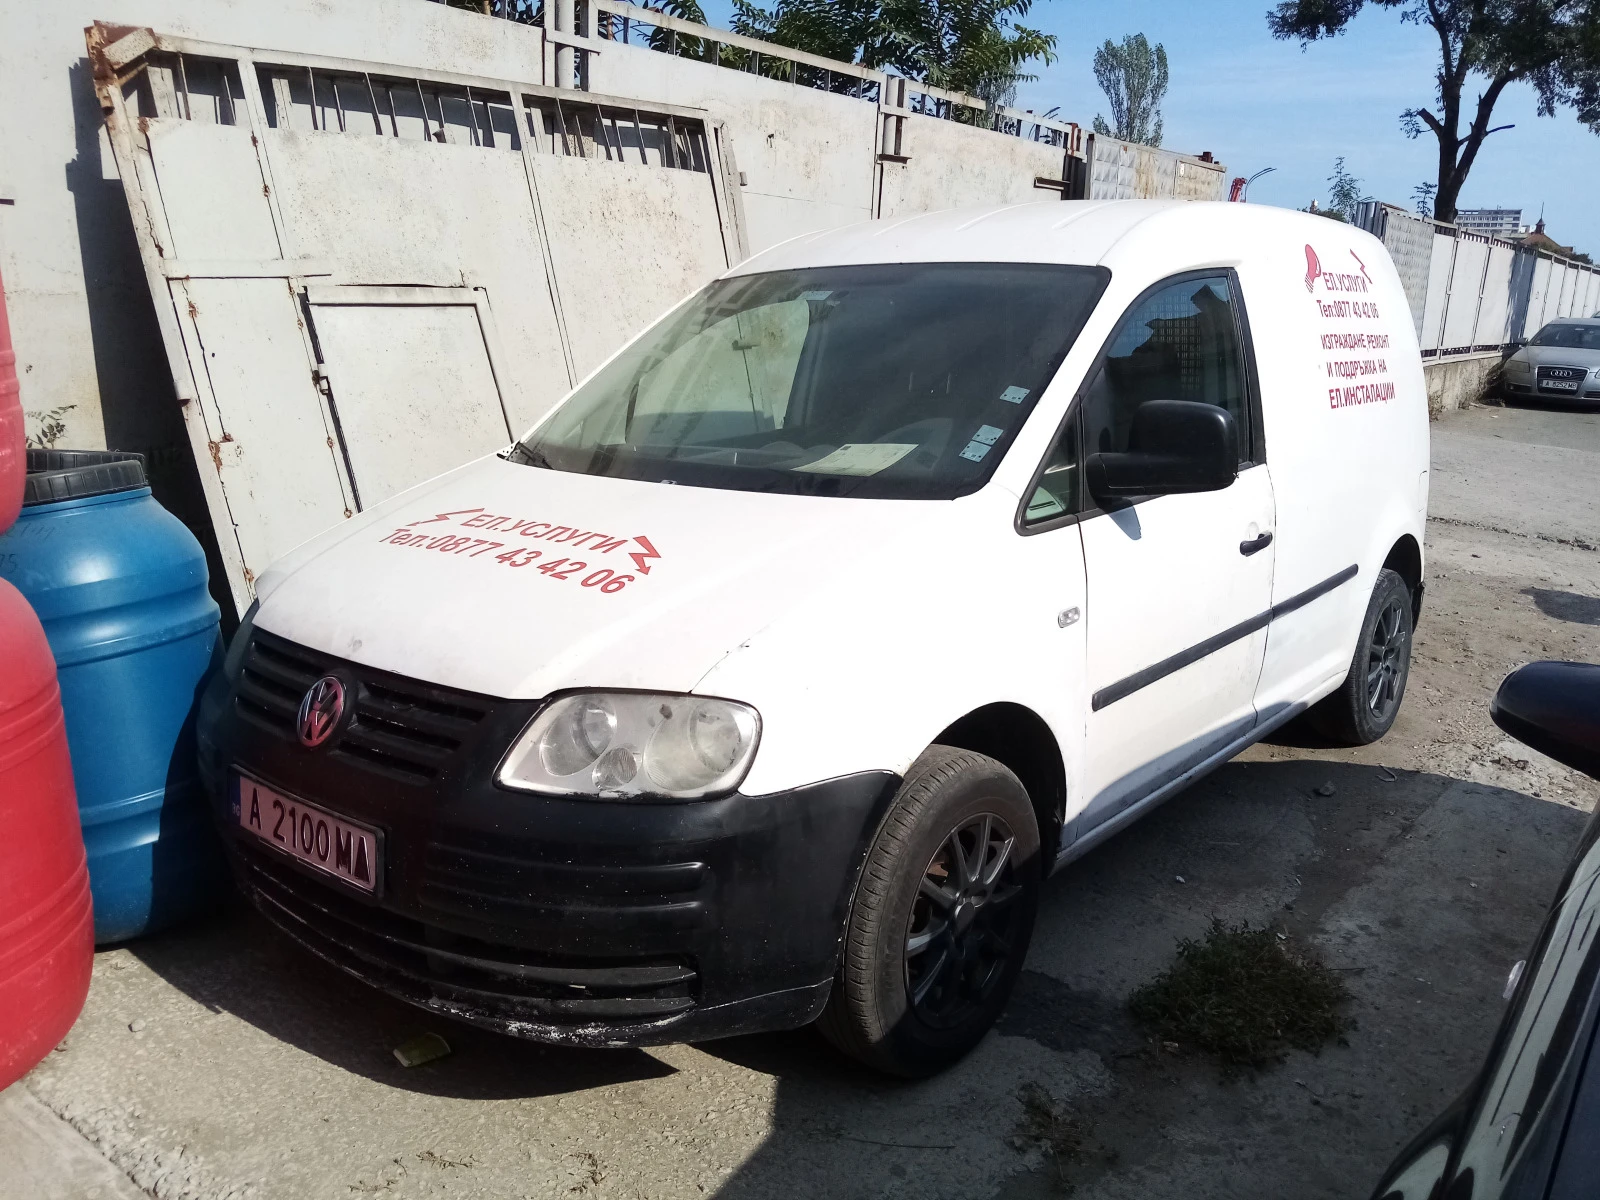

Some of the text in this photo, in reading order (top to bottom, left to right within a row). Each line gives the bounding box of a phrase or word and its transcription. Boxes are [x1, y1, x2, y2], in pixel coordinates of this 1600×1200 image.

[1322, 271, 1369, 293] ЕЛ.УСЛУГИ
[1352, 301, 1362, 318] 43
[1362, 301, 1371, 318] 42
[1370, 302, 1379, 318] 06
[1326, 358, 1388, 379] И ПОДДРЪЖКА НА
[1328, 381, 1396, 410] ЕЛ.ИНСТАЛАЦИИ
[460, 513, 628, 554] ЕЛ.УСЛУГИ
[494, 547, 543, 568] 43
[537, 557, 588, 580] 42
[580, 568, 635, 594] 06
[272, 800, 331, 862] 2100
